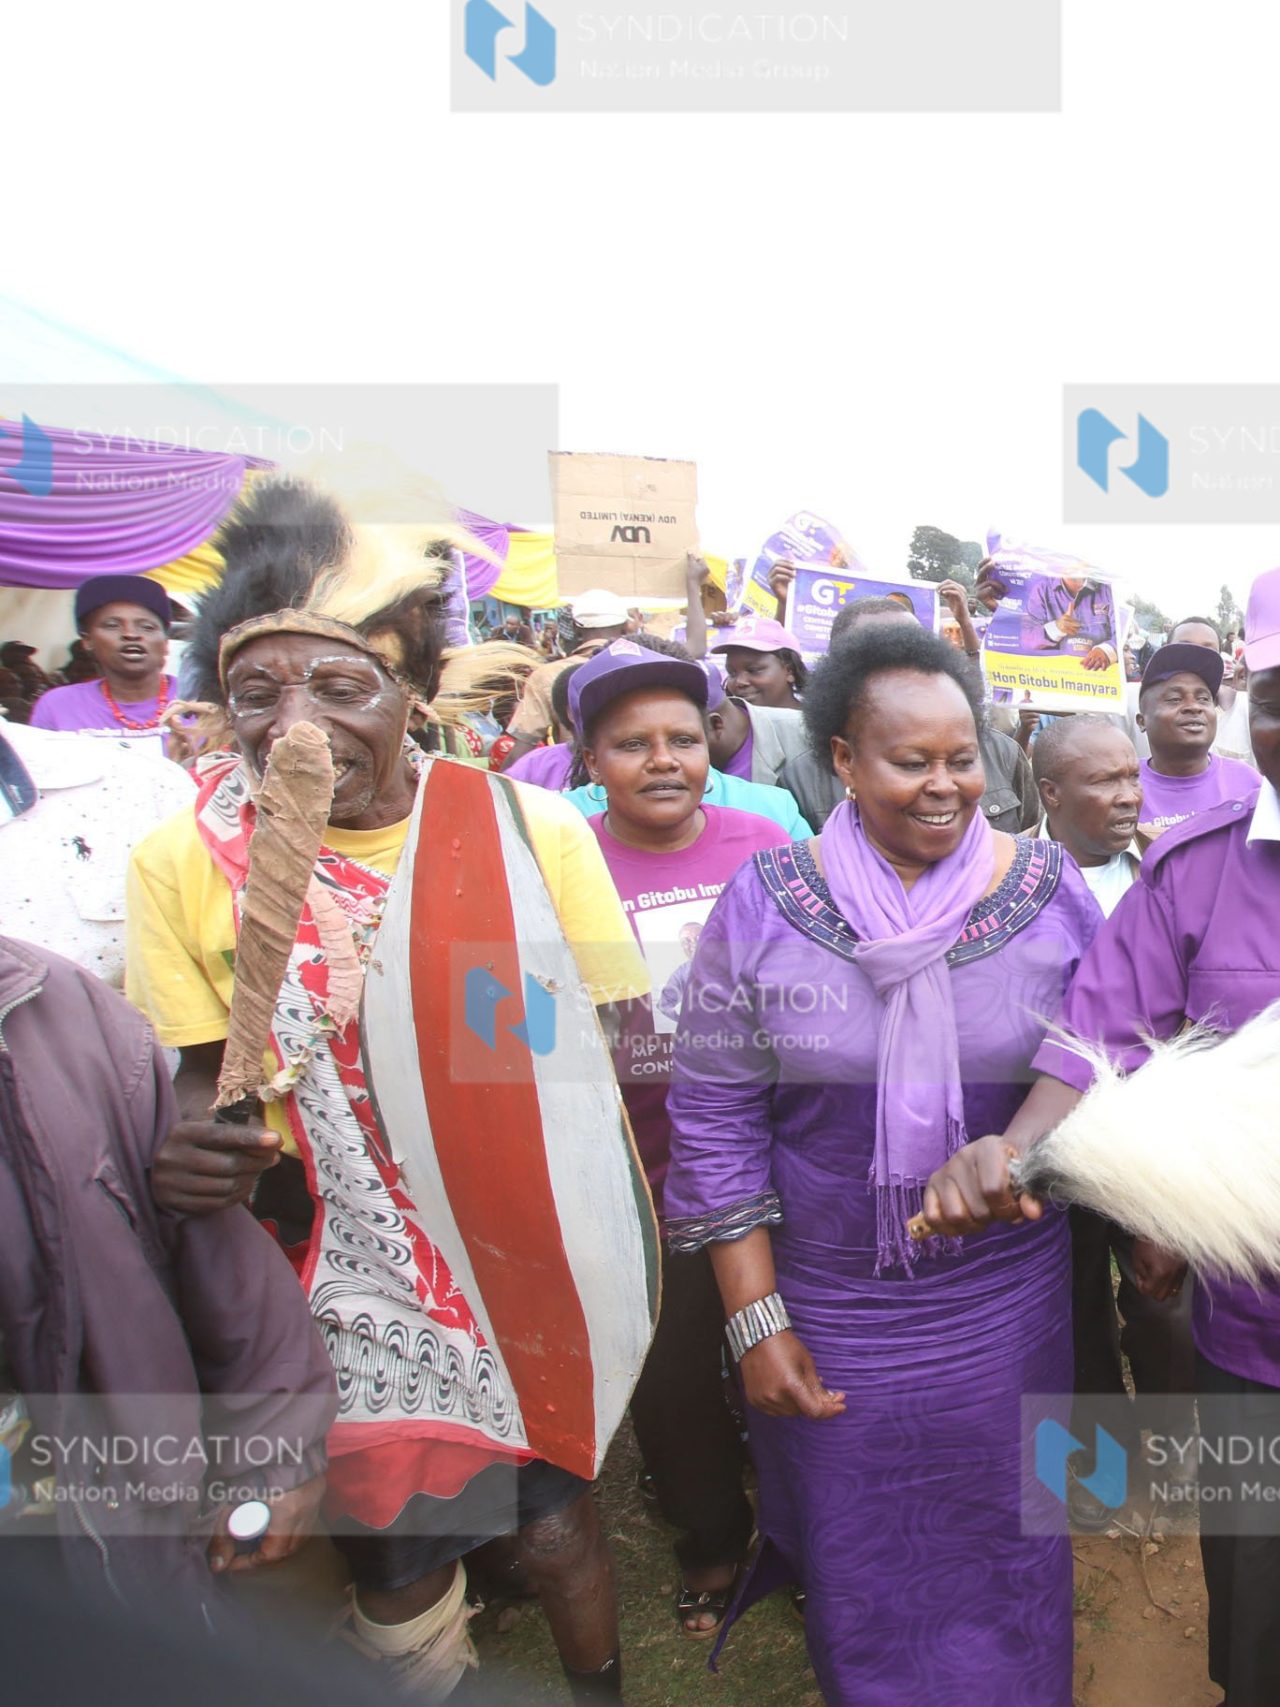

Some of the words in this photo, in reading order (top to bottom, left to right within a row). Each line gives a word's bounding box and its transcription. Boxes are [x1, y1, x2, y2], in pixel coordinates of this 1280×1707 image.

[579, 511, 617, 521] LIMITED
[619, 512, 656, 523] (KENYA)
[658, 515, 677, 524] UDV
[610, 525, 651, 544] UDV
[992, 671, 1016, 684] Hon
[1019, 673, 1058, 688] Gitobu
[1061, 677, 1118, 696] Imanyara
[637, 886, 698, 909] Gitobu
[631, 1043, 657, 1058] MP
